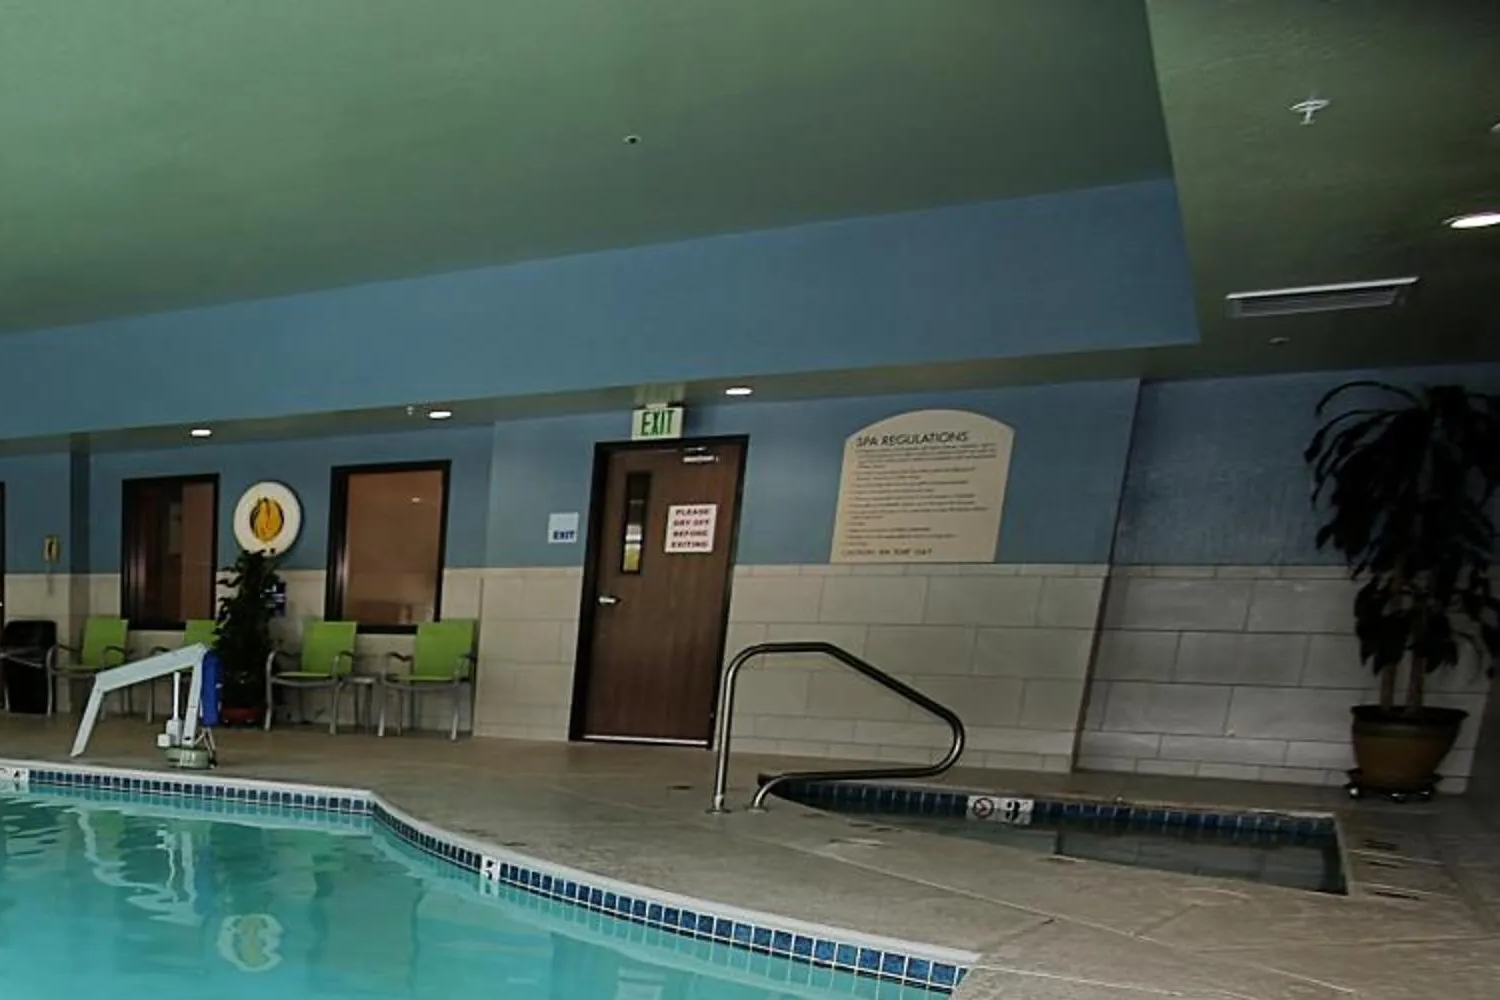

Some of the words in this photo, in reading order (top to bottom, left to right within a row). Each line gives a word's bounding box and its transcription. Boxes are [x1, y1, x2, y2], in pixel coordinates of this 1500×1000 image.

[641, 410, 676, 436] EXIT
[881, 432, 969, 446] REGULATIONS
[553, 530, 576, 540] EXIT
